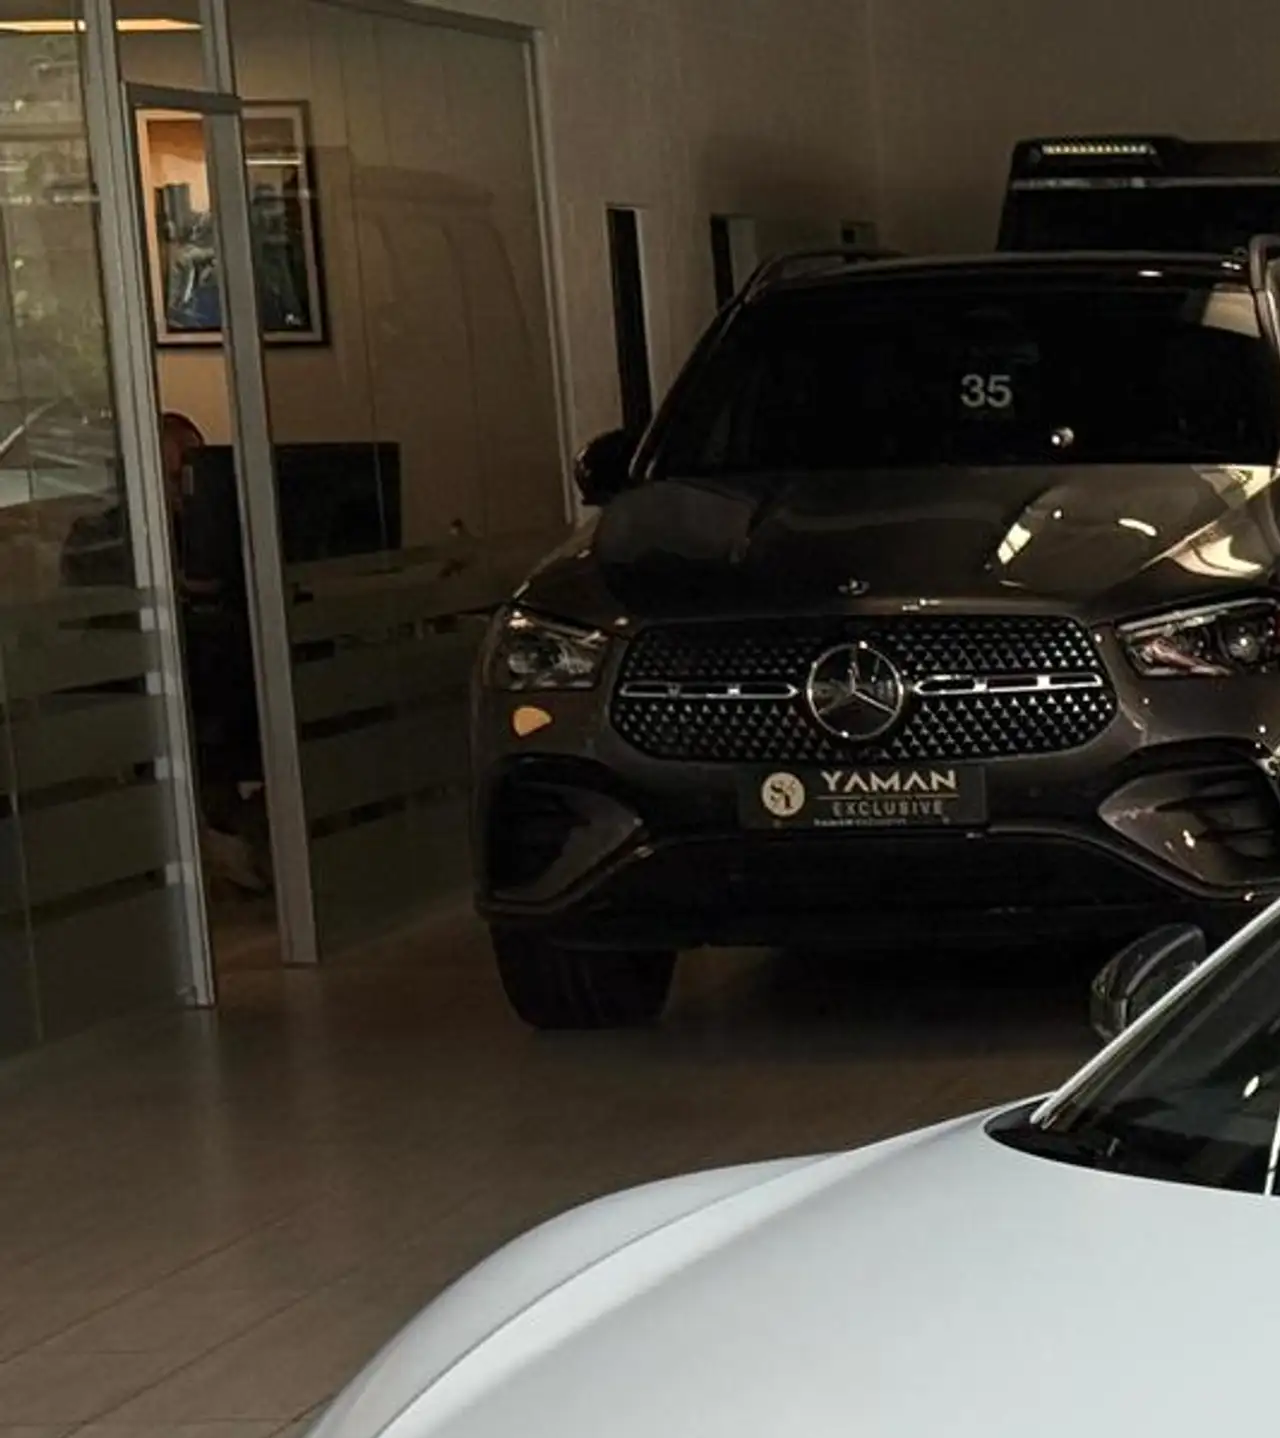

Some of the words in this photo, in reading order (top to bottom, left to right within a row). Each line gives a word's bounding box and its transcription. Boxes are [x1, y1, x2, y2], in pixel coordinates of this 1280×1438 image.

[960, 373, 1013, 409] 35
[820, 769, 958, 793] YAMAN
[831, 800, 944, 818] EXCLUSIVE
